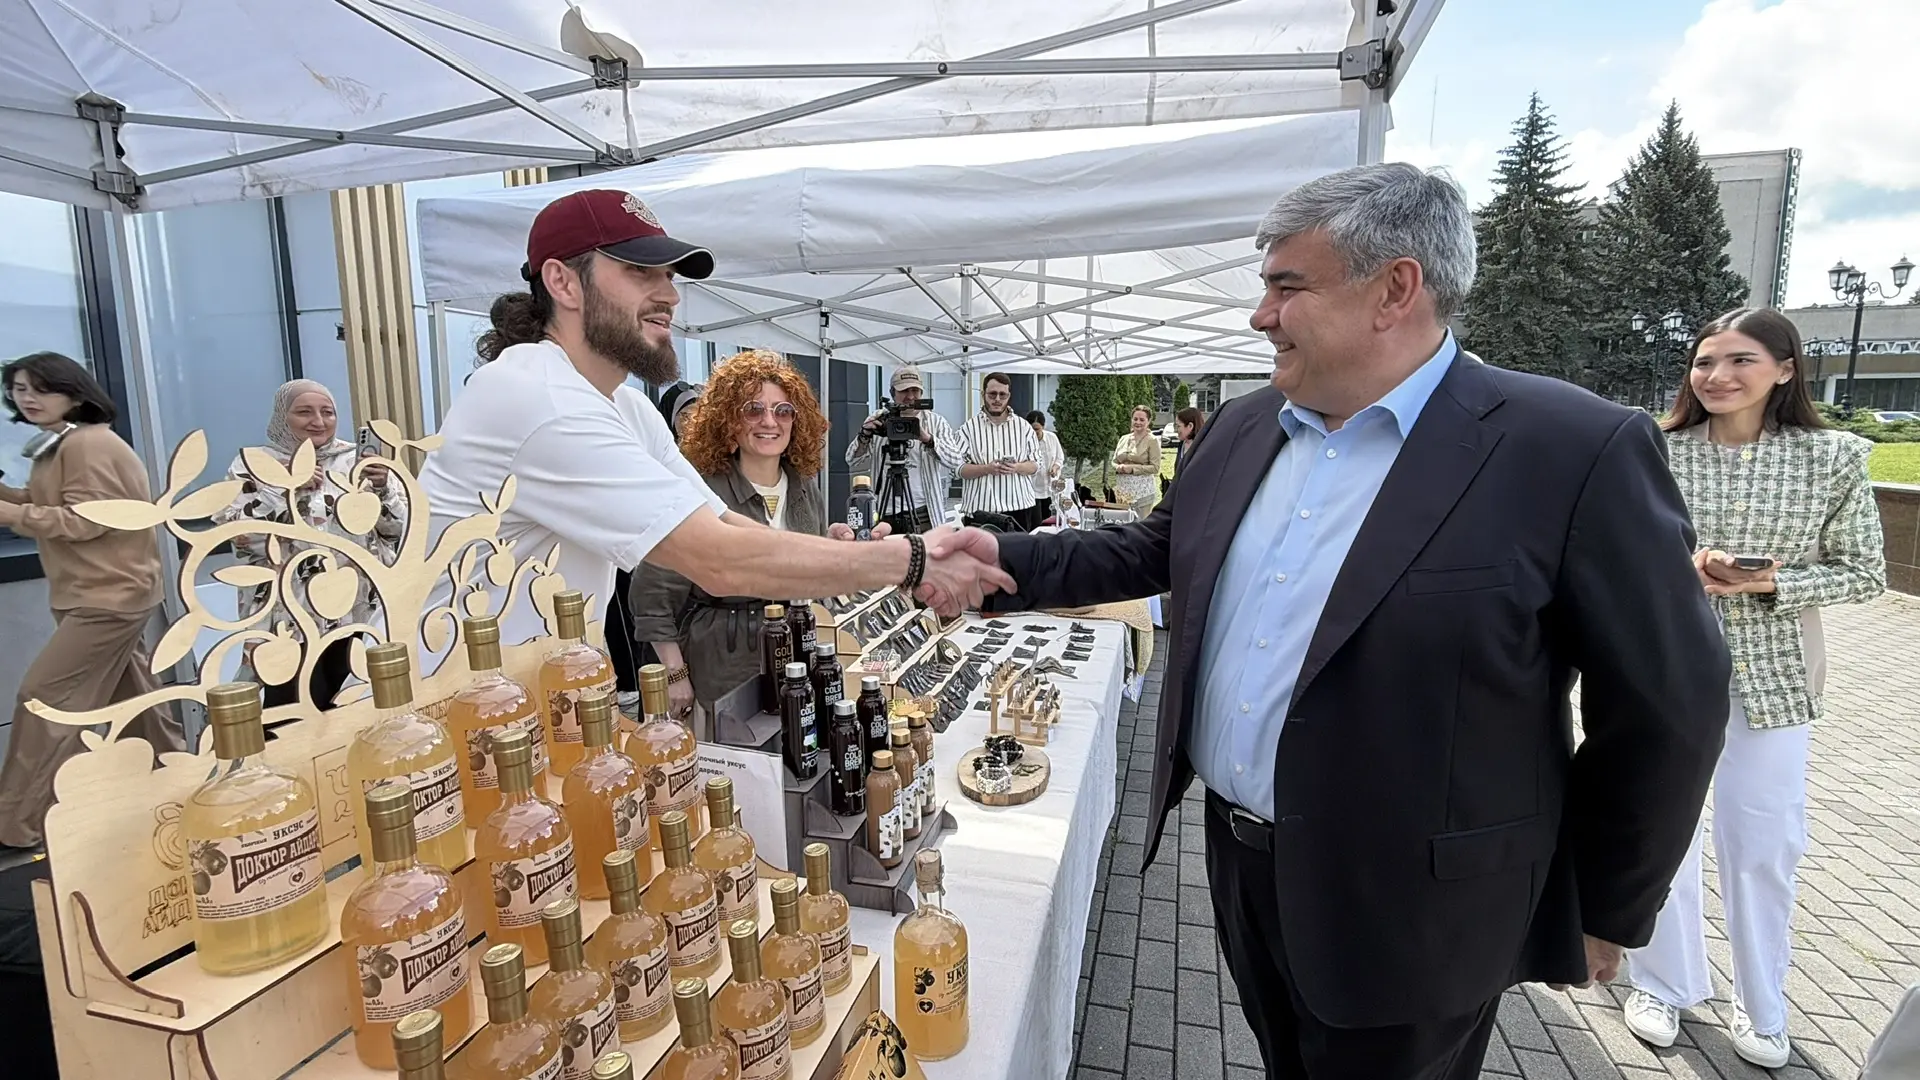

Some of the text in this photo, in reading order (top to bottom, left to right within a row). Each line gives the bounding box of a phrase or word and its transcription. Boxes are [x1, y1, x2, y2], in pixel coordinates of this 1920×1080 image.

[847, 512, 863, 520] COLD
[825, 685, 842, 694] COLD
[844, 750, 862, 760] COLD
[413, 784, 444, 811] ОКТОР
[272, 820, 304, 840] УКСУС
[235, 847, 287, 889] ДОКТОР
[529, 865, 564, 900] ДОКТОР
[437, 917, 460, 939] УКСУС
[677, 921, 706, 948] ДОКТОР
[405, 944, 448, 989] ДОКТОР
[742, 1040, 773, 1068] ДОКТОР
